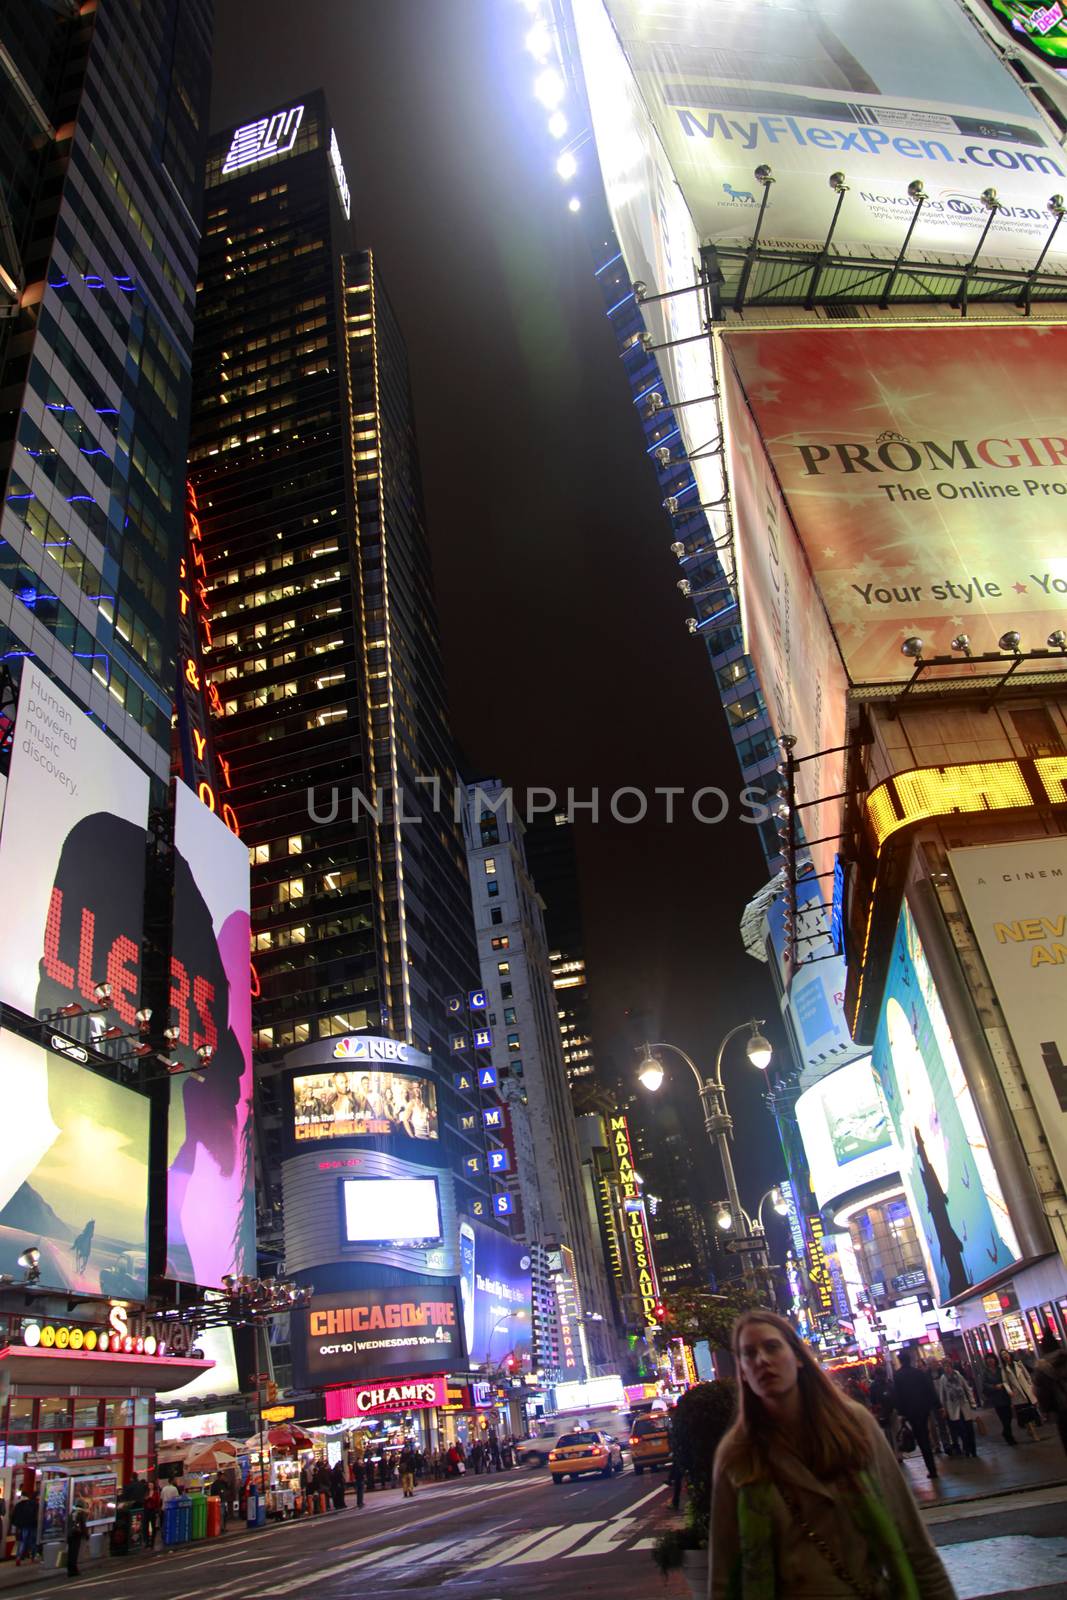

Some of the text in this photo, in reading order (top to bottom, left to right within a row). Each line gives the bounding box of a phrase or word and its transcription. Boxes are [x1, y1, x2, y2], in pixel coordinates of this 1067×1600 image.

[676, 109, 1066, 178] MyFlexPen.com
[995, 206, 1041, 220] 0/30
[879, 484, 931, 502] The
[937, 480, 1020, 500] Online
[852, 583, 922, 605] Your
[931, 576, 1002, 604] style
[29, 674, 72, 726] Human
[24, 719, 60, 758] music
[27, 699, 78, 752] powered
[22, 738, 79, 797] discovery.
[368, 1040, 408, 1061] NBC
[472, 992, 508, 1211] CHAMPS
[611, 1117, 636, 1198] MADAME
[310, 1303, 417, 1337] CHICAGO
[420, 1302, 456, 1326] FIRE
[555, 1273, 576, 1369] AMSTERDAM
[320, 1344, 341, 1355] OCT
[342, 1343, 352, 1352] 10
[356, 1336, 418, 1350] WEDNESDAYS
[356, 1383, 436, 1412] CHAMPS
